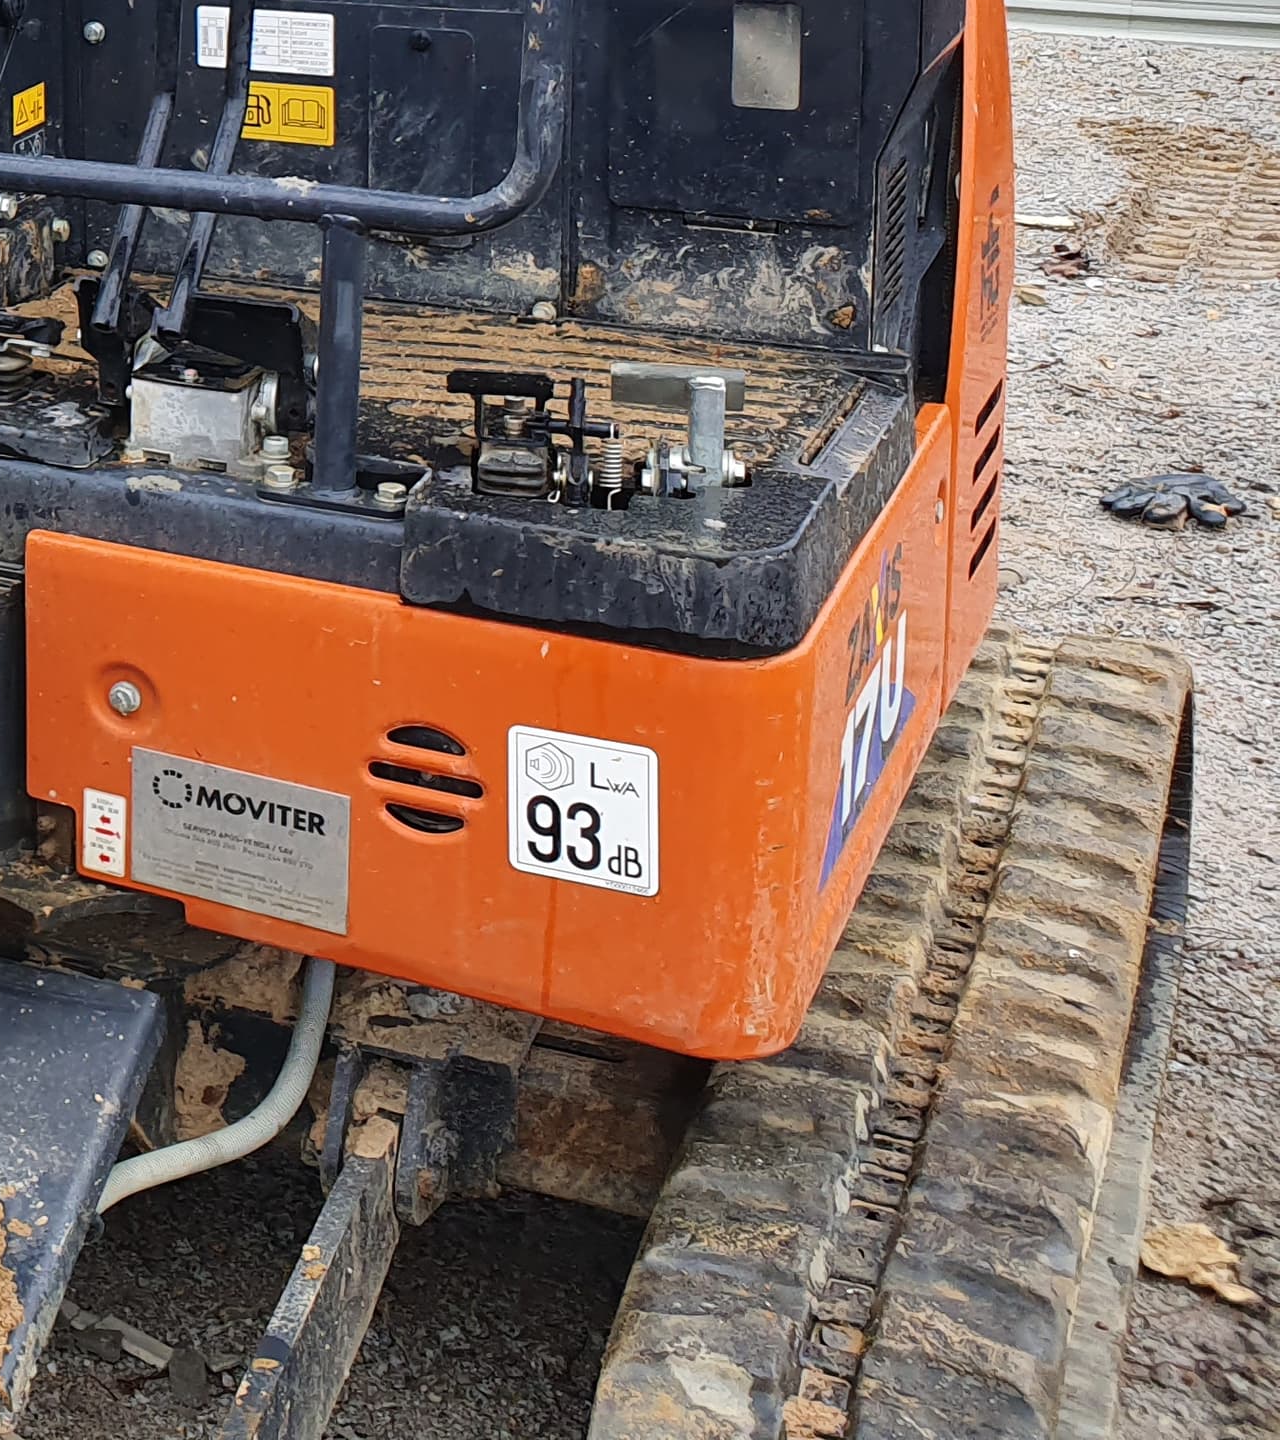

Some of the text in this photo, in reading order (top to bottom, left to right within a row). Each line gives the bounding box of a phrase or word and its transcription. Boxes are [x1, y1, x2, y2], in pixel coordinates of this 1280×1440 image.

[841, 608, 907, 828] 17U
[196, 786, 326, 836] MOVITER
[526, 795, 643, 878] 93 dB
